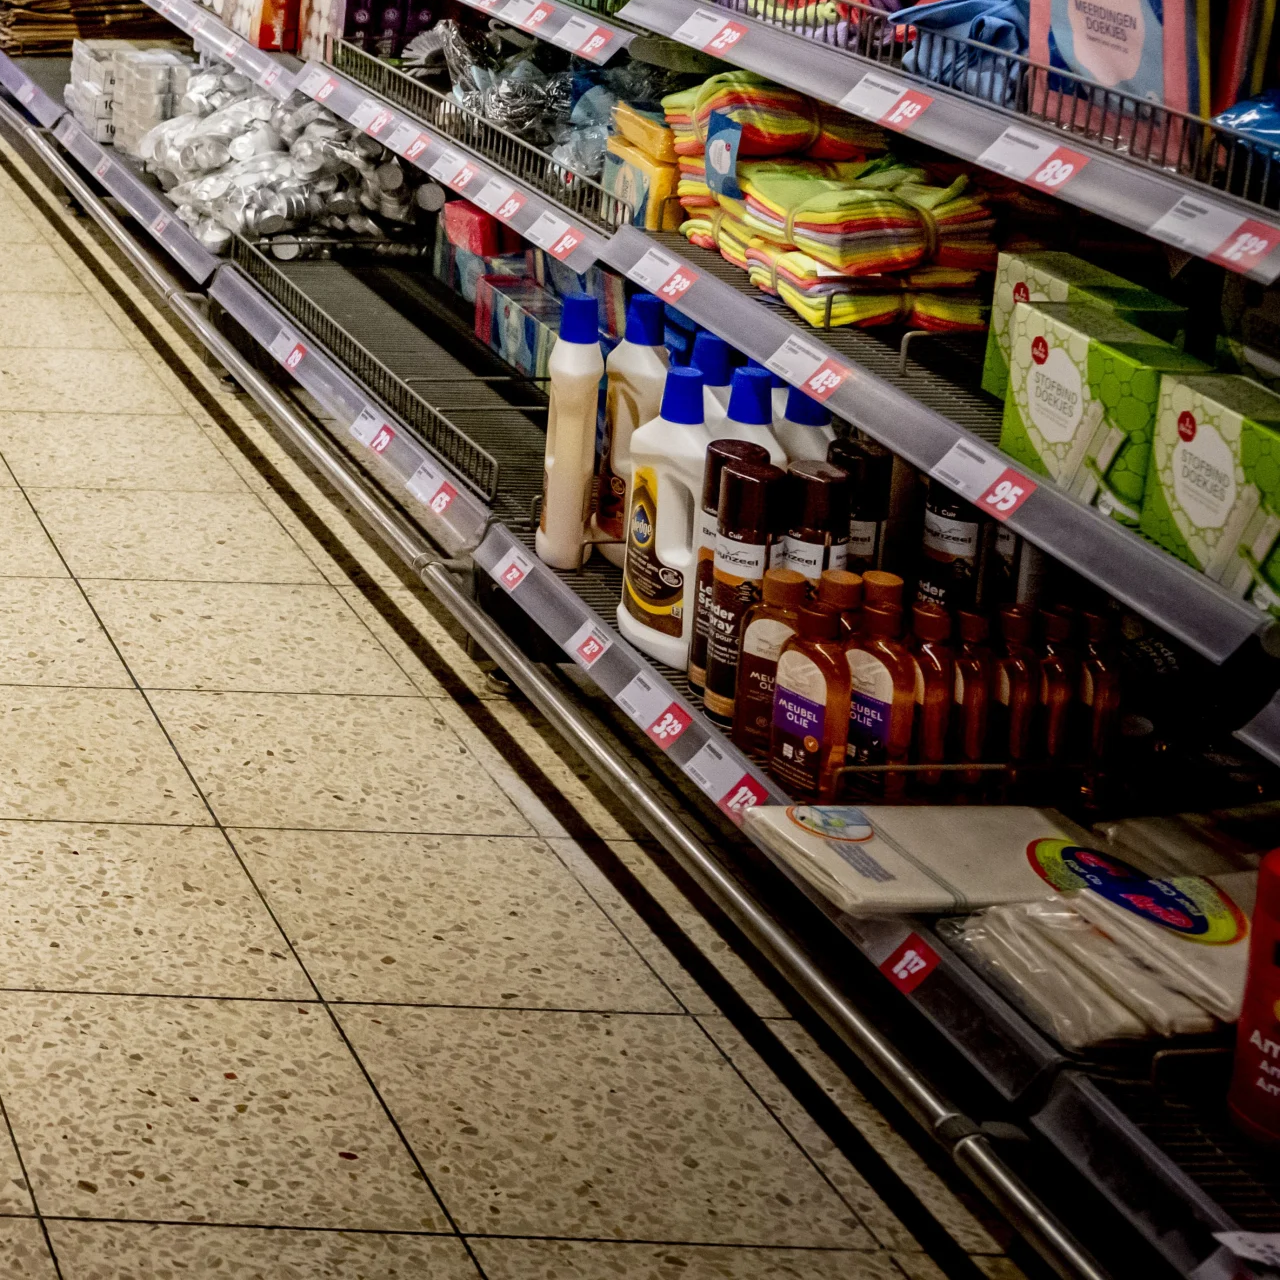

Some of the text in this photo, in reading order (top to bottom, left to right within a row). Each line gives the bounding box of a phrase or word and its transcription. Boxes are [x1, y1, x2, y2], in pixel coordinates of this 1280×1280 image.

[706, 23, 741, 52] 2.39
[1085, 16, 1128, 43] DOEKJES
[883, 100, 921, 125] 1.43
[452, 165, 474, 187] 79
[1035, 158, 1074, 187] 89
[497, 197, 520, 219] 99
[661, 272, 692, 296] 3.39
[809, 366, 841, 394] 4.39
[1033, 371, 1078, 405] STOFBIND
[1035, 385, 1074, 419] DOEKJES
[370, 426, 392, 452] 79
[1181, 448, 1230, 488] STOFBIND
[986, 480, 1025, 511] 95
[1181, 463, 1226, 502] DOEKJES
[431, 489, 454, 514] 65
[728, 531, 744, 541] Cuir
[778, 697, 819, 724] MEUBEL
[786, 711, 810, 730] OLIE
[648, 711, 682, 743] 3.29
[890, 949, 927, 980] 1.17
